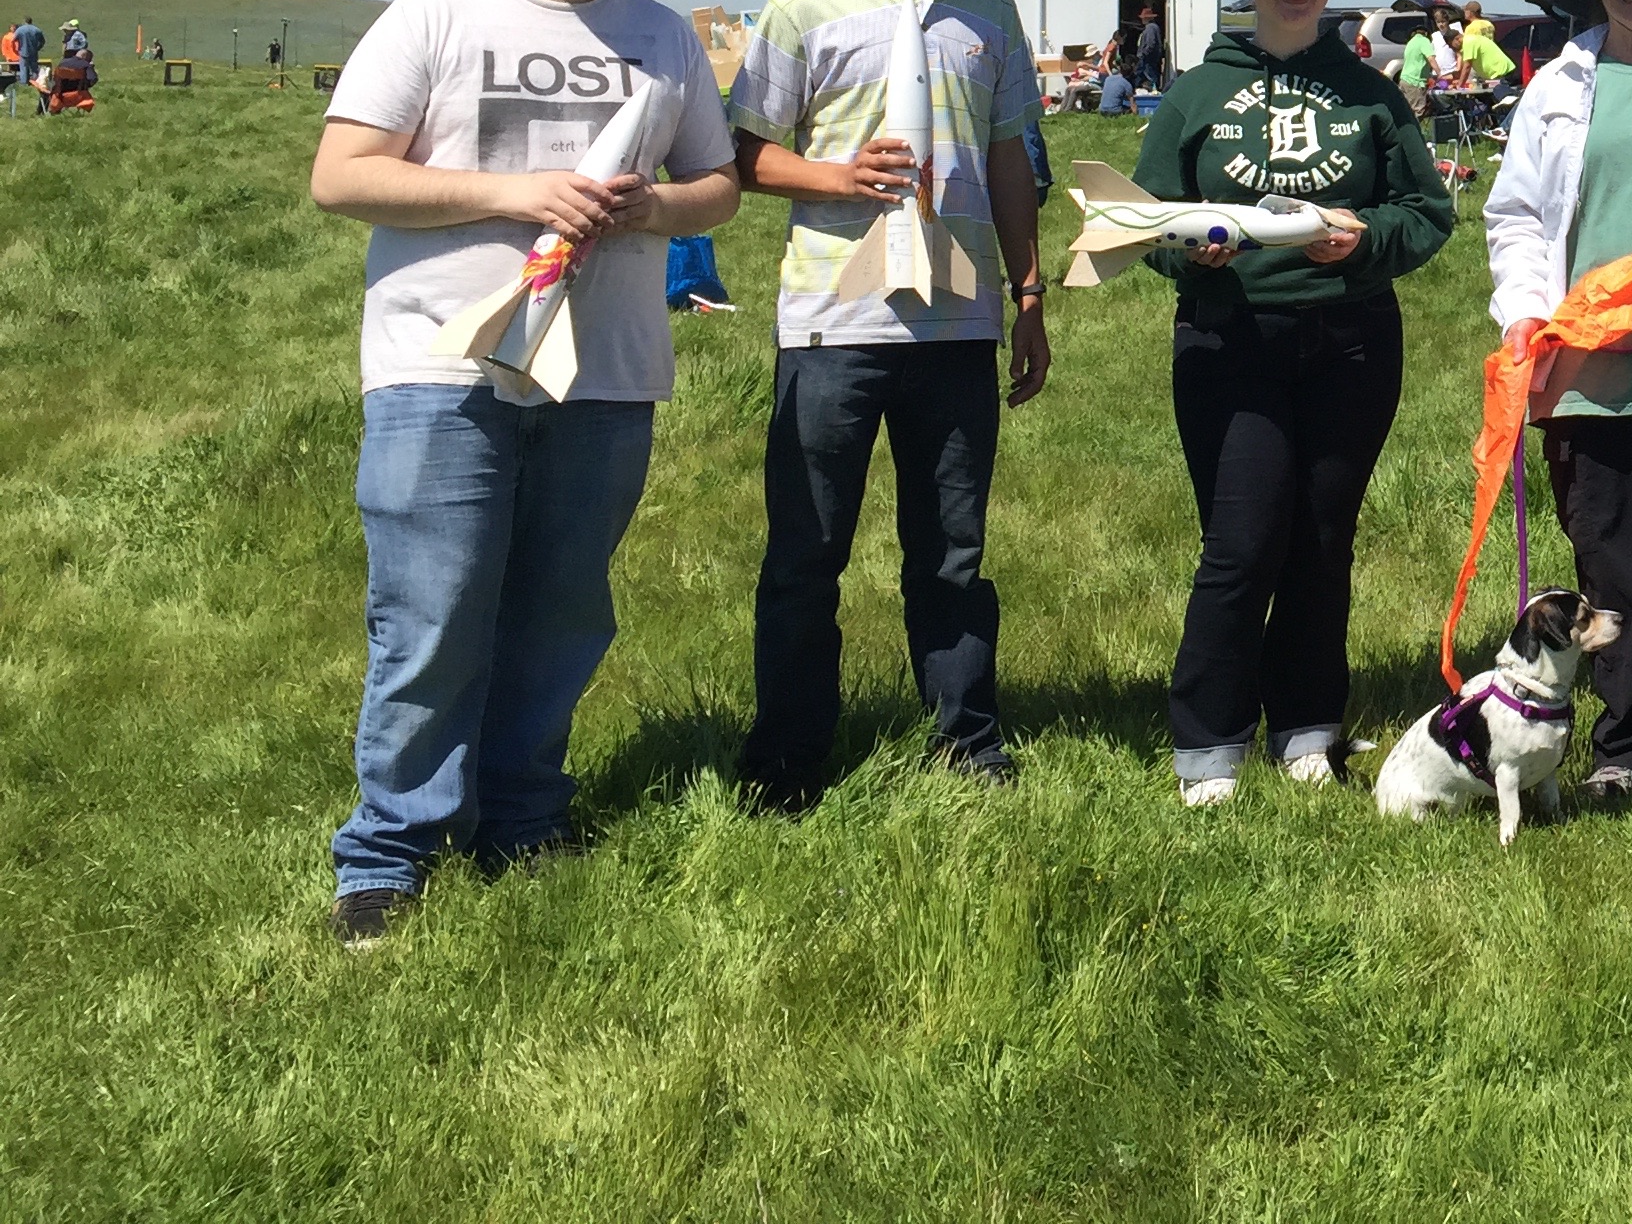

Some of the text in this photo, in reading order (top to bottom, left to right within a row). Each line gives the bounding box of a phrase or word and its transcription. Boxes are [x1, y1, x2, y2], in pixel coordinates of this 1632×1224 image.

[482, 50, 643, 97] LOST
[1224, 73, 1343, 114] DHS MUSIC
[550, 139, 576, 153] ctrl
[1212, 123, 1243, 140] 2013
[1329, 119, 1361, 136] 2014
[1223, 149, 1353, 194] MADRIGALS
